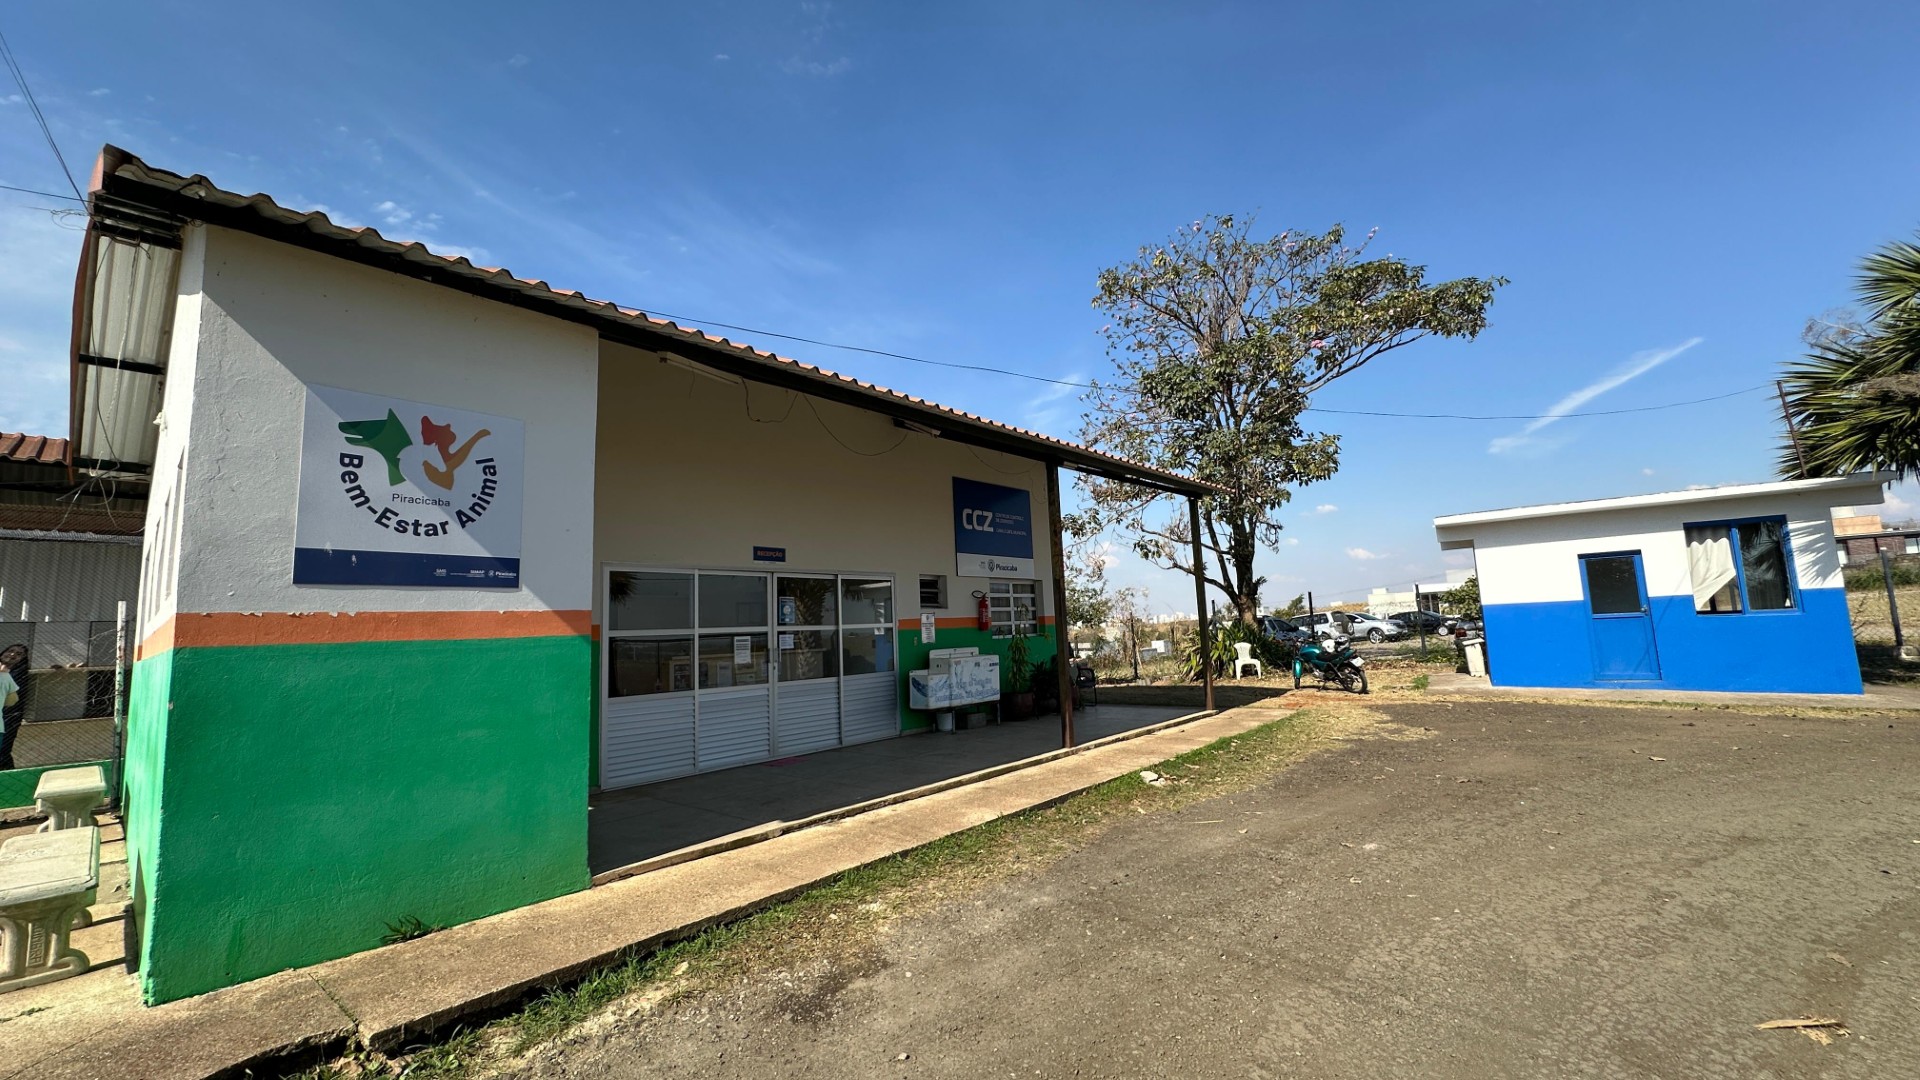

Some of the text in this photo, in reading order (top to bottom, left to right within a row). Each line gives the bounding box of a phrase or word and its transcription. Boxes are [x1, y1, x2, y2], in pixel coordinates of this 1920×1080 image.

[340, 452, 498, 537] Bem-Estar Animal
[392, 493, 451, 507] Piracicaba
[962, 508, 994, 532] CCZ
[996, 563, 1018, 572] Piracicaba
